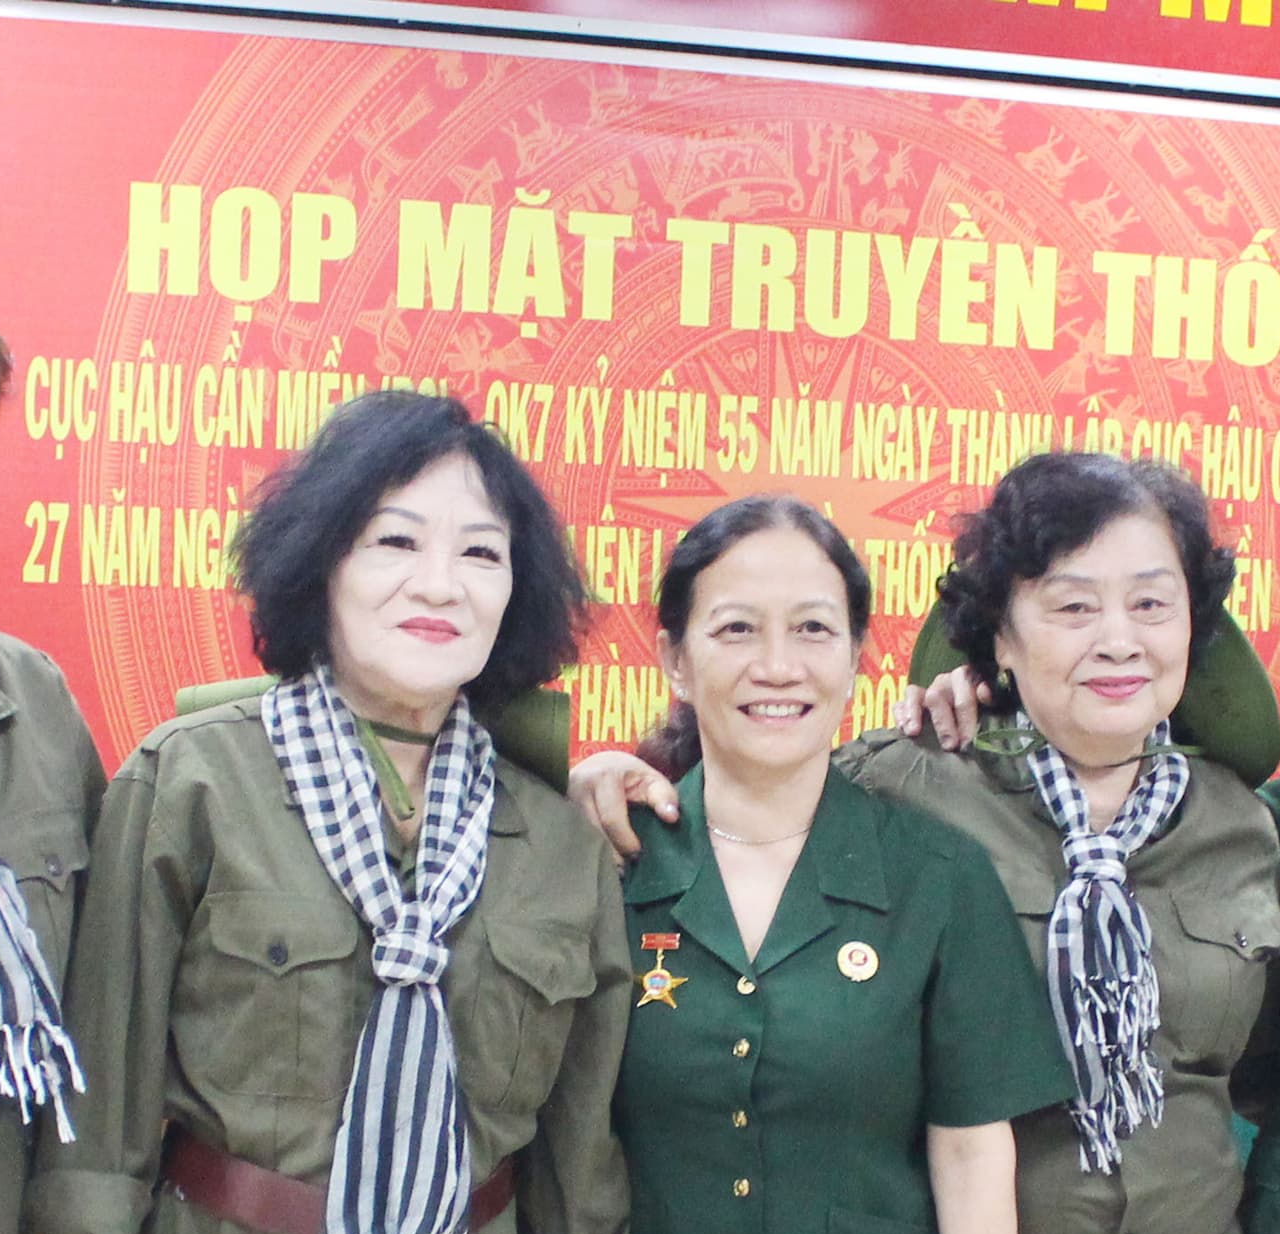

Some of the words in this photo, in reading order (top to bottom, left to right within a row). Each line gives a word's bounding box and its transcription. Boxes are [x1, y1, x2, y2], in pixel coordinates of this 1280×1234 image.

[127, 180, 358, 324] HỌP
[397, 187, 633, 340] MẶT
[666, 202, 1058, 352] TRUYỀN
[24, 355, 98, 461] CỤC
[108, 339, 182, 465] HẬU
[192, 329, 266, 452] CẦN
[564, 354, 614, 466] KỶ
[621, 369, 708, 490] NIỆM
[717, 395, 760, 474] 55
[769, 382, 844, 480] NĂM
[851, 383, 938, 484] NGÀY
[1200, 404, 1264, 520] HẬU
[22, 499, 70, 584] 27
[81, 486, 162, 588] NĂM
[173, 486, 254, 590] NGÀ
